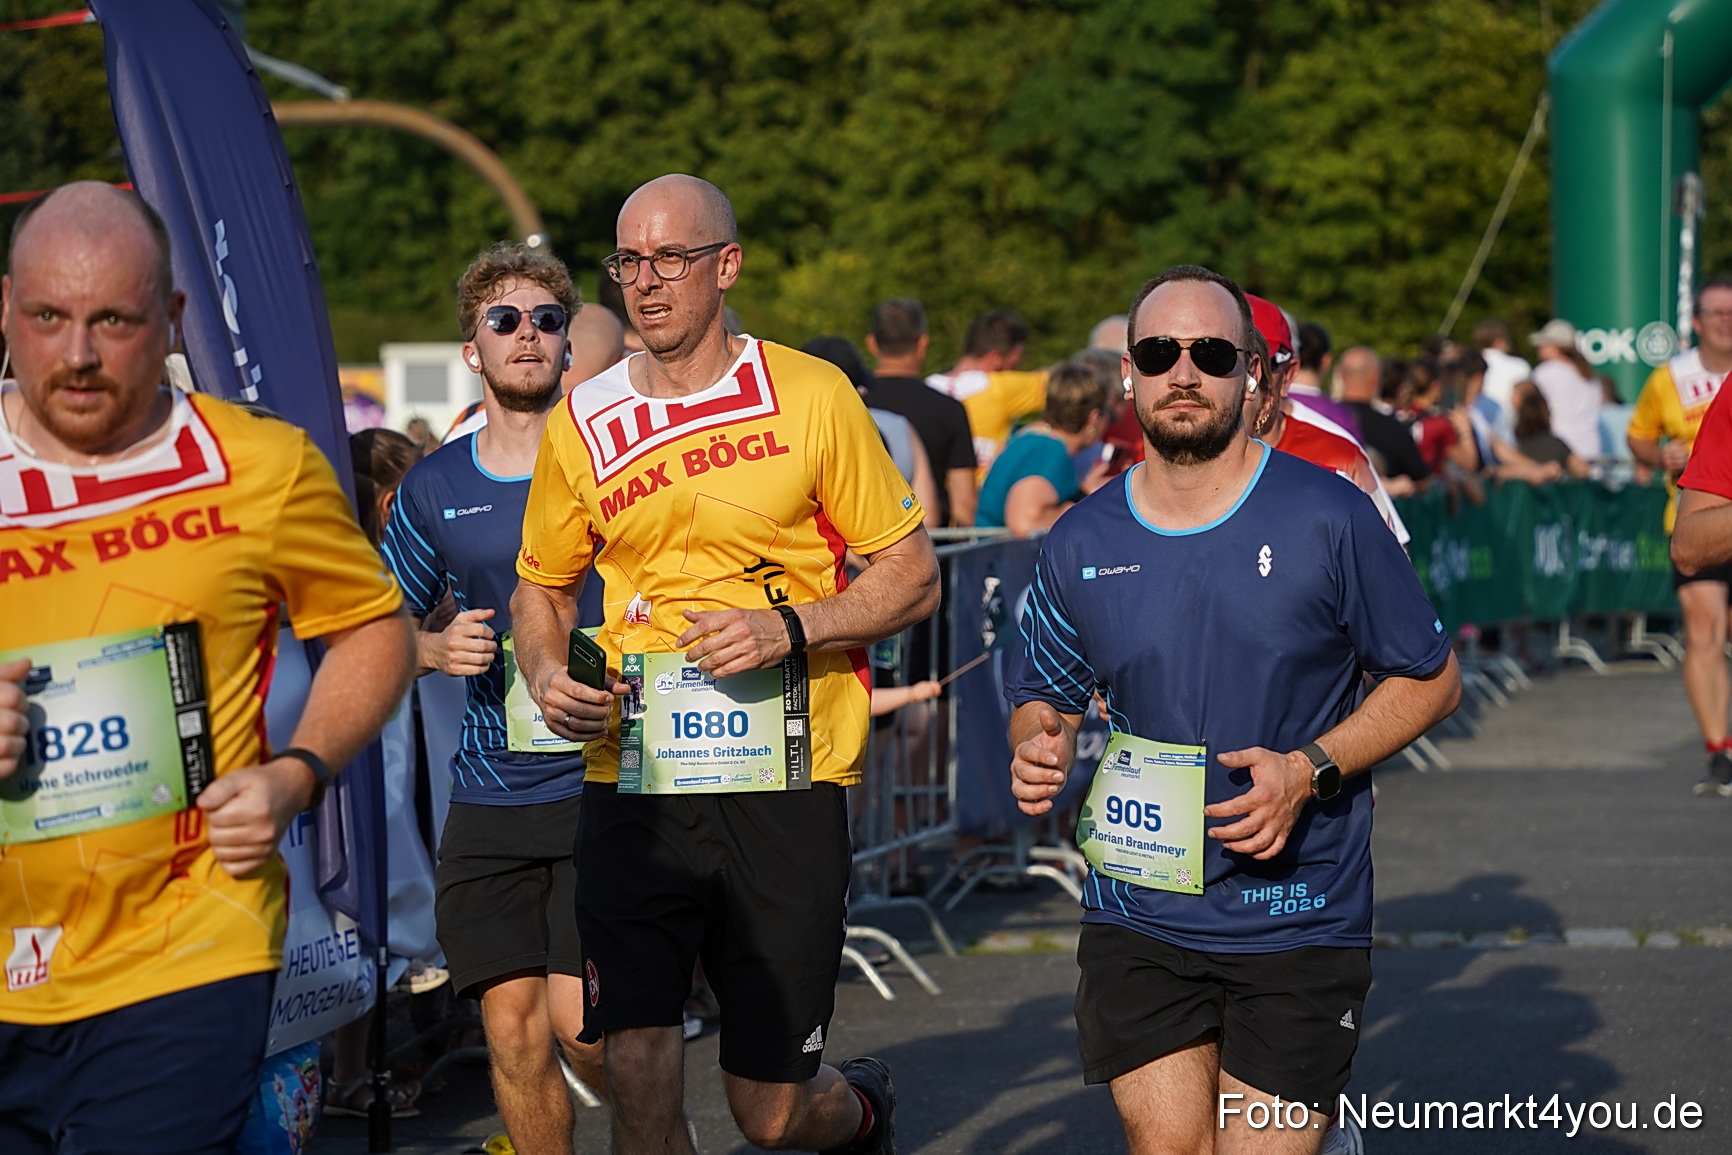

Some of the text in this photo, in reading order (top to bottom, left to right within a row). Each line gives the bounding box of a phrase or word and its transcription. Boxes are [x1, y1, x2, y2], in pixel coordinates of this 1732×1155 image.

[599, 430, 790, 523] MAX BÖGL
[92, 506, 240, 563] BÖGL
[623, 664, 641, 673] AOK
[676, 679, 717, 689] Firmenlauf
[785, 699, 792, 711] 20
[671, 710, 749, 739] 1680
[655, 745, 772, 759] Johannes Gritzbach
[790, 739, 799, 780] HILTL
[64, 760, 150, 786] Schroeder
[1111, 763, 1142, 775] Firmenlauf
[1105, 795, 1162, 832] 905
[1089, 827, 1187, 858] Florian Brandmeyr
[1241, 882, 1308, 905] THIS IS
[1268, 893, 1326, 917] 2026
[286, 935, 336, 980] HEUTE
[270, 979, 351, 1028] MORGEN
[802, 1040, 824, 1053] adidas
